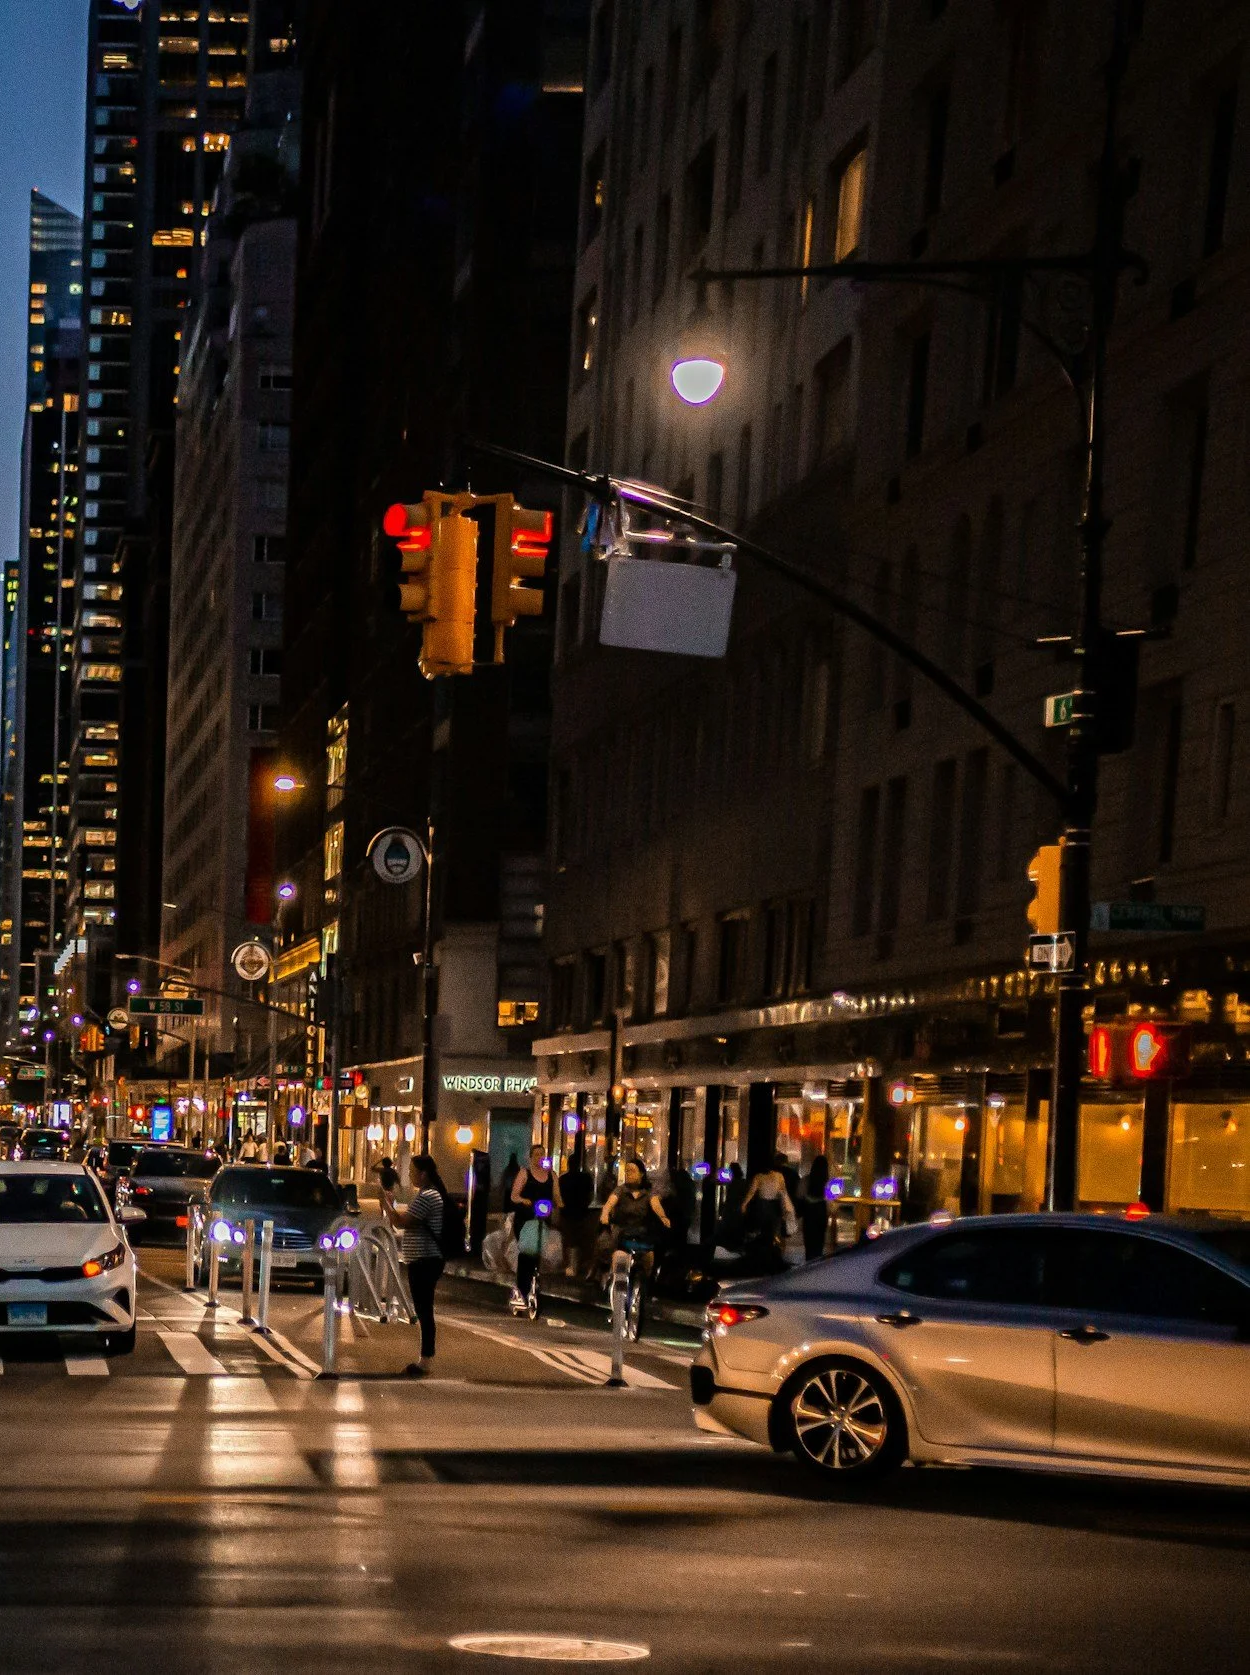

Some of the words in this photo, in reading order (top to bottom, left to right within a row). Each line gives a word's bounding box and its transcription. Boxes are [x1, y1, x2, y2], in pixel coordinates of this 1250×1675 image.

[1111, 905, 1165, 920] CENTRAL
[1172, 906, 1203, 919] PARK
[148, 1001, 156, 1011] W
[159, 1001, 171, 1012] 58
[443, 1075, 501, 1091] WINDSOR
